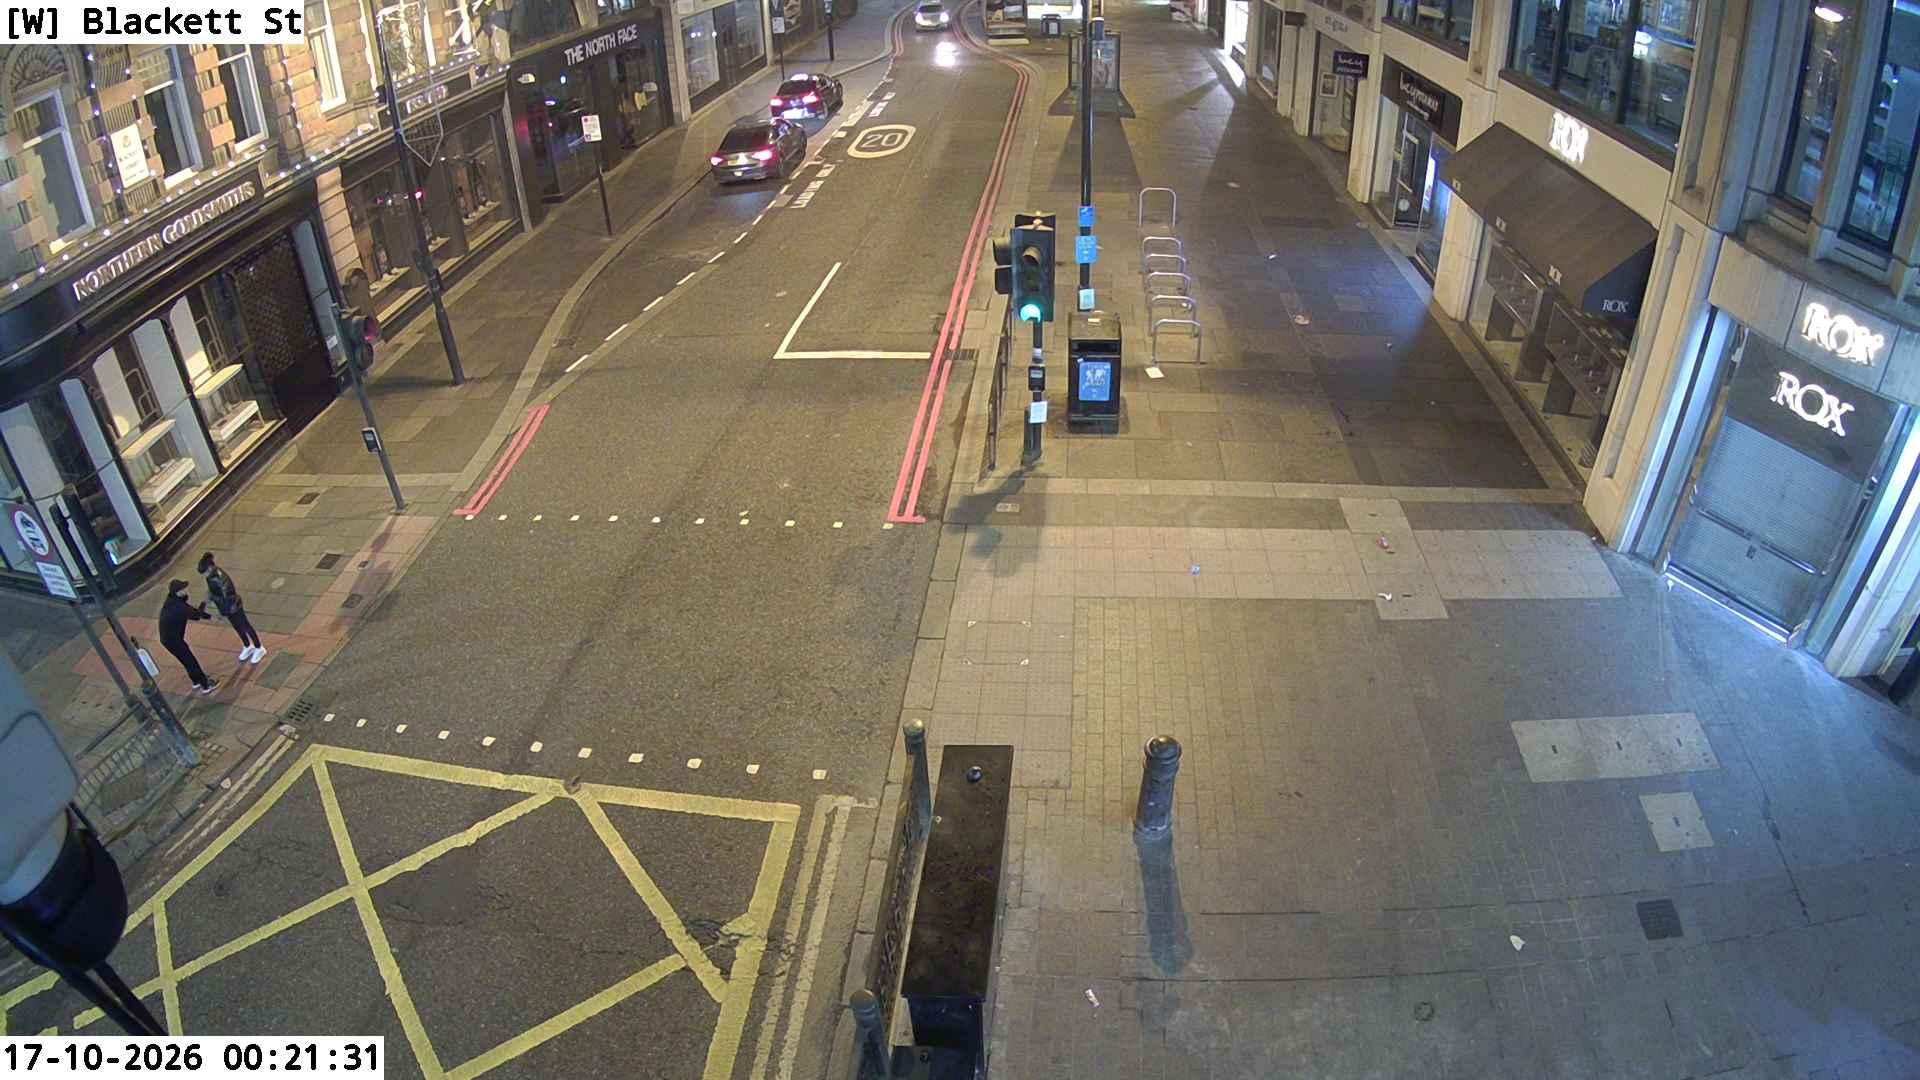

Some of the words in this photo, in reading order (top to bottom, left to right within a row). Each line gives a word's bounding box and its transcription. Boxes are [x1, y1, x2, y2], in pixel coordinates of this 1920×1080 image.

[564, 44, 584, 66] THE
[585, 32, 616, 59] NORTH
[617, 24, 638, 46] FACE
[861, 132, 902, 148] 20
[72, 232, 164, 301] NORTHERN
[162, 180, 257, 245] GOLDSMITHS
[1602, 299, 1629, 313] ROX
[1801, 302, 1885, 367] ROX
[1770, 371, 1856, 437] ROX
